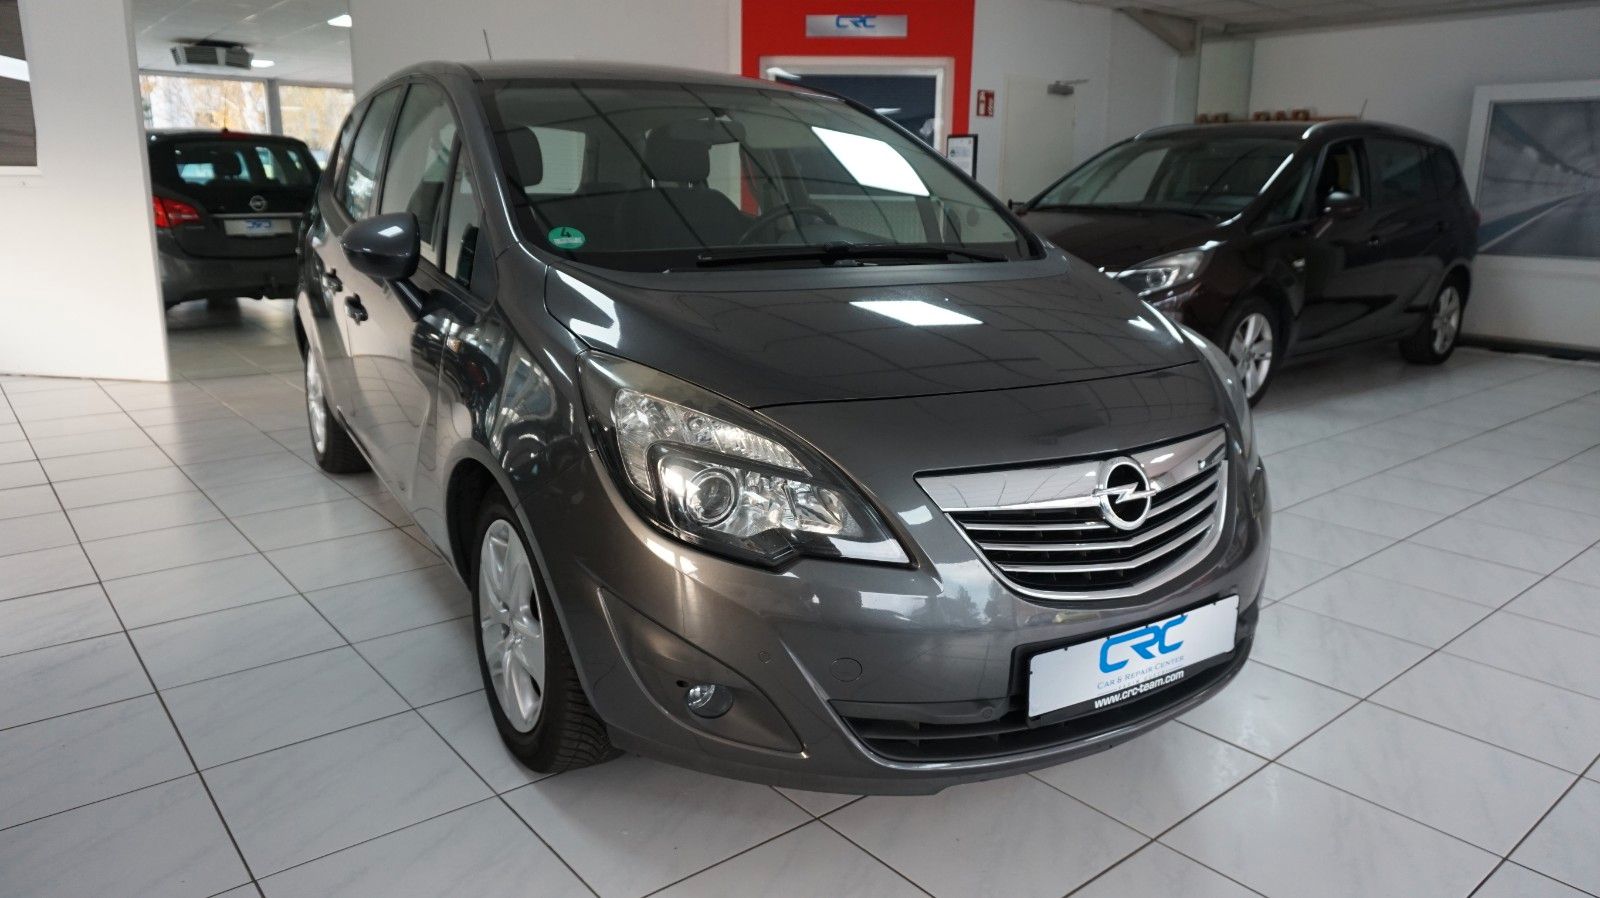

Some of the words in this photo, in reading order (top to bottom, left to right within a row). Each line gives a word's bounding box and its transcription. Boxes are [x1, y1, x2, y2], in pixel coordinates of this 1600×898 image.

[835, 15, 877, 28] CRC
[560, 227, 572, 238] 4
[1099, 614, 1188, 673] CRC
[1094, 670, 1185, 709] www.crc-team.com
